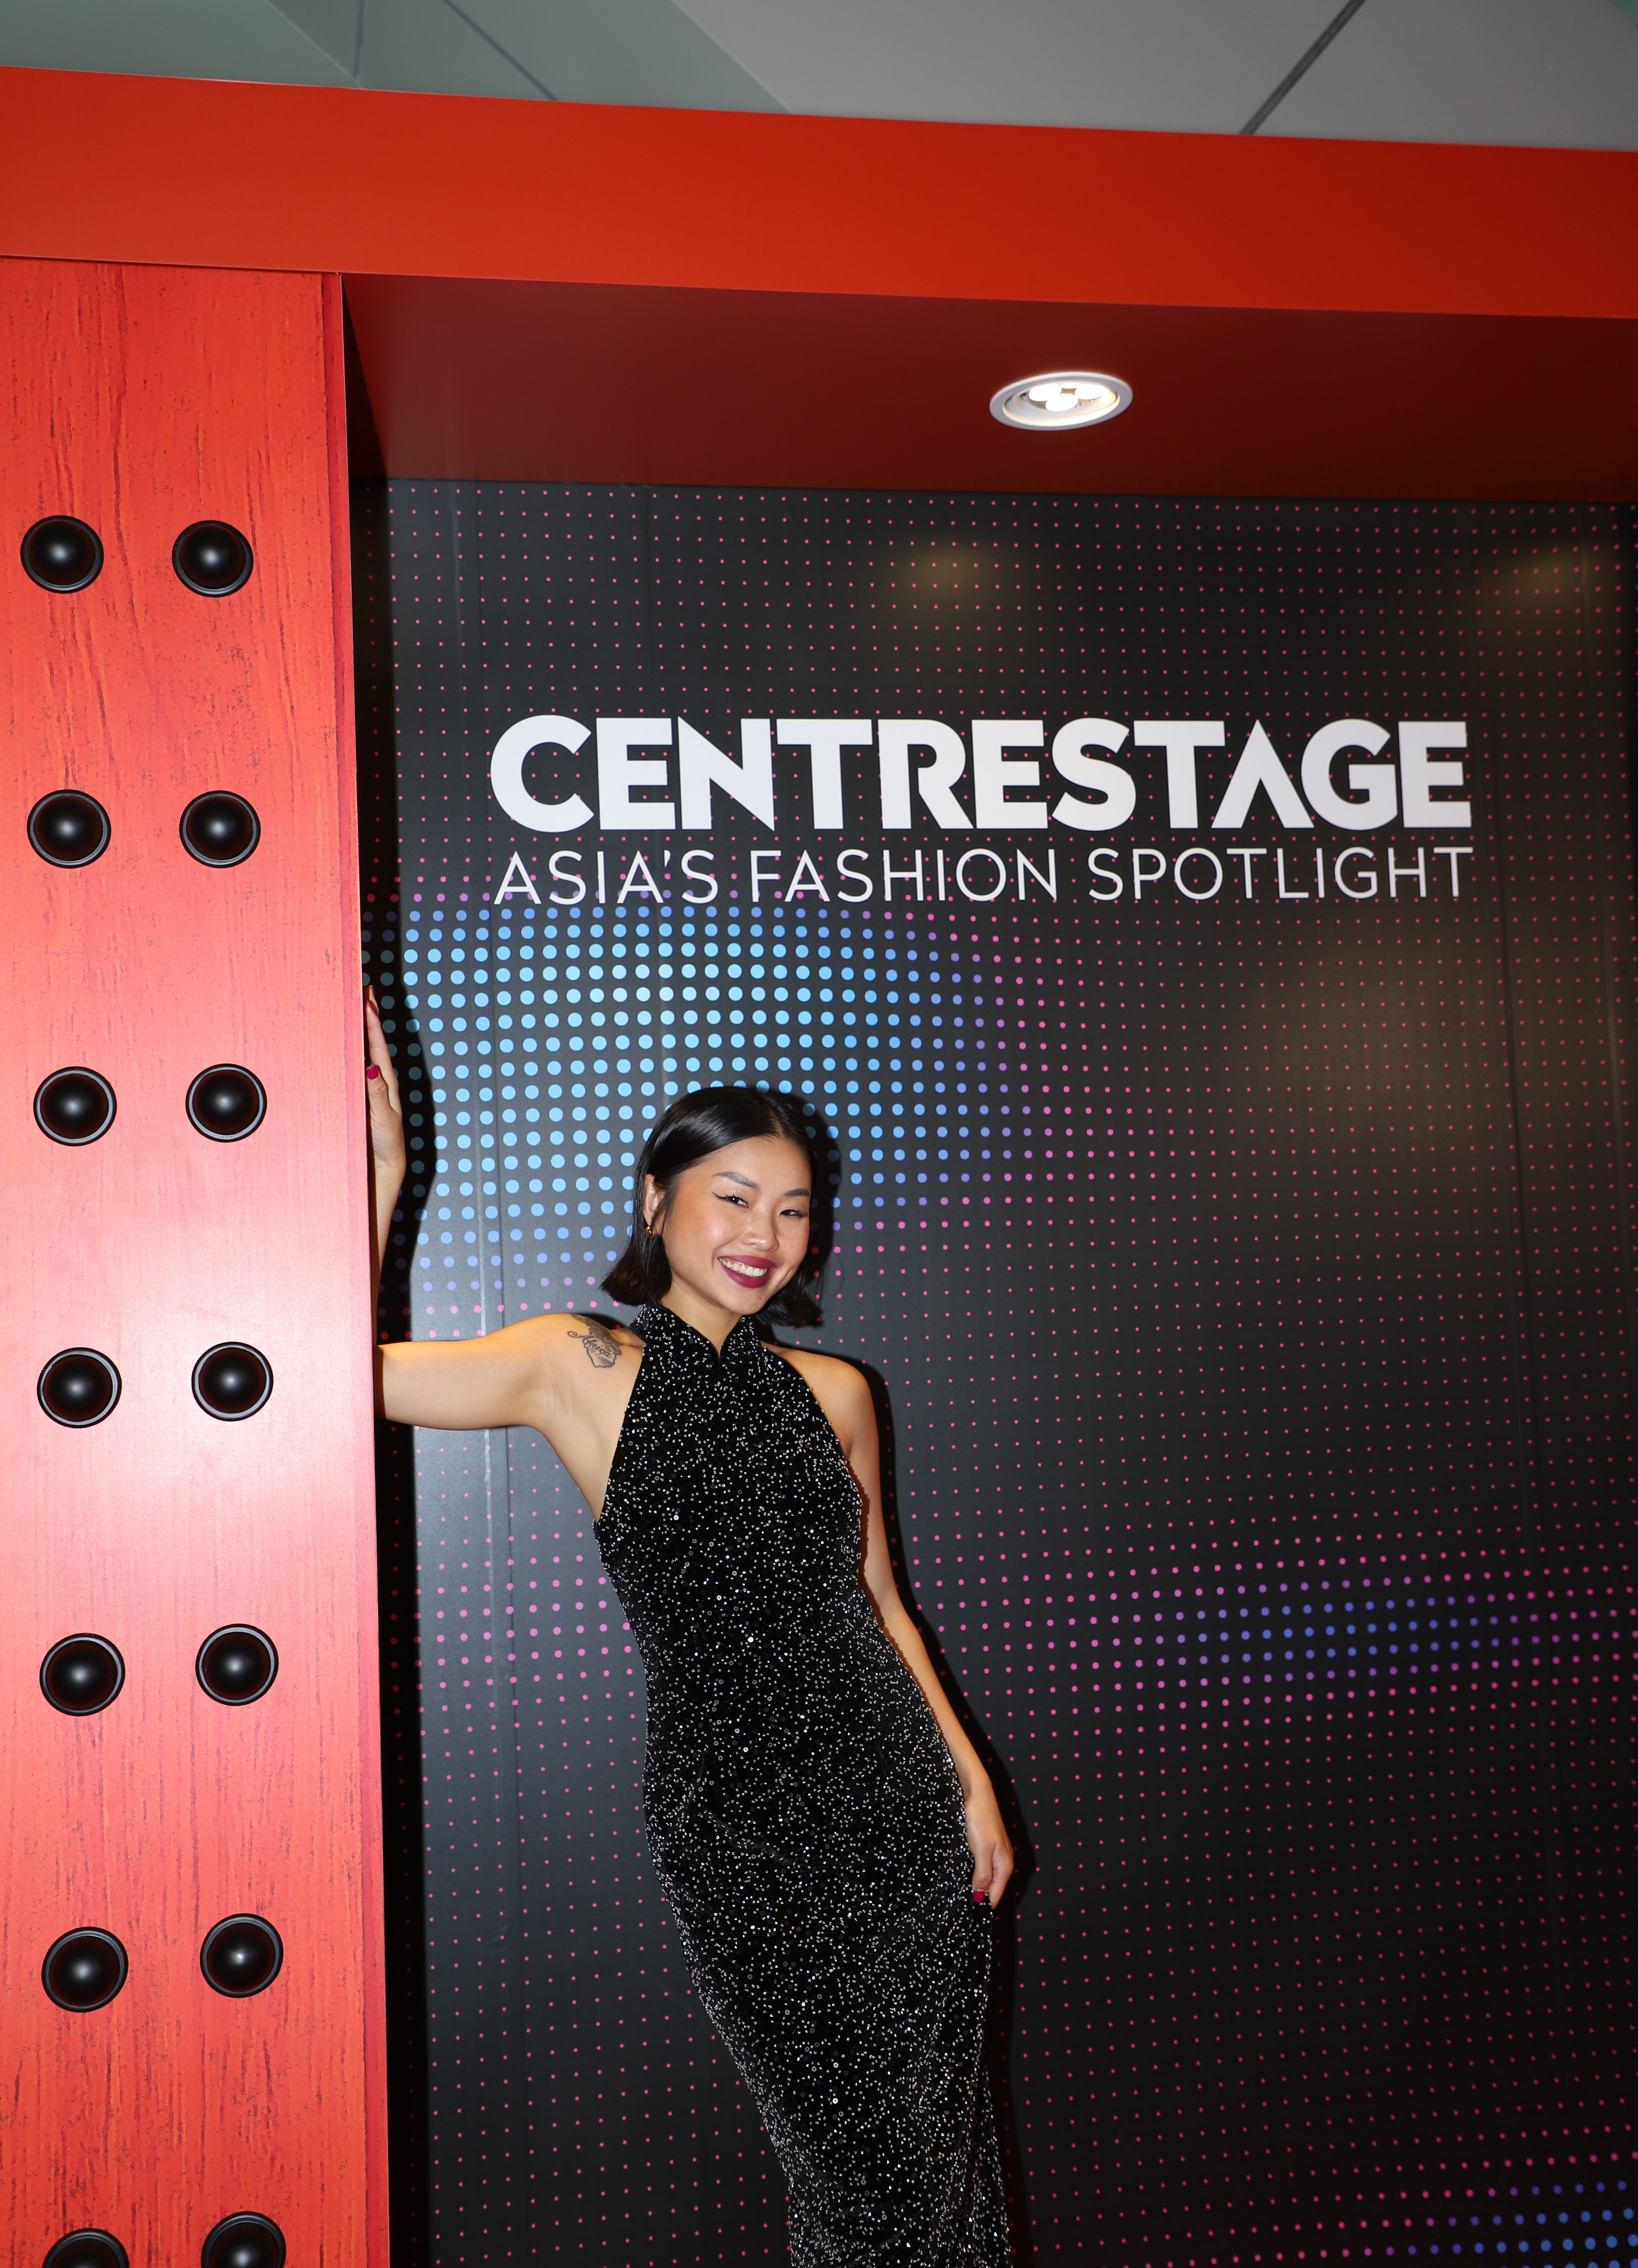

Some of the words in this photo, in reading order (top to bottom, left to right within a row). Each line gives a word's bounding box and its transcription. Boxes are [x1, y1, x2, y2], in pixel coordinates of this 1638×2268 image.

[490, 715, 1472, 833] CENTRESTAGE
[494, 849, 718, 905] ASIA'S
[750, 849, 1057, 902] FASHION
[1088, 847, 1473, 901] SPOTLIGHT
